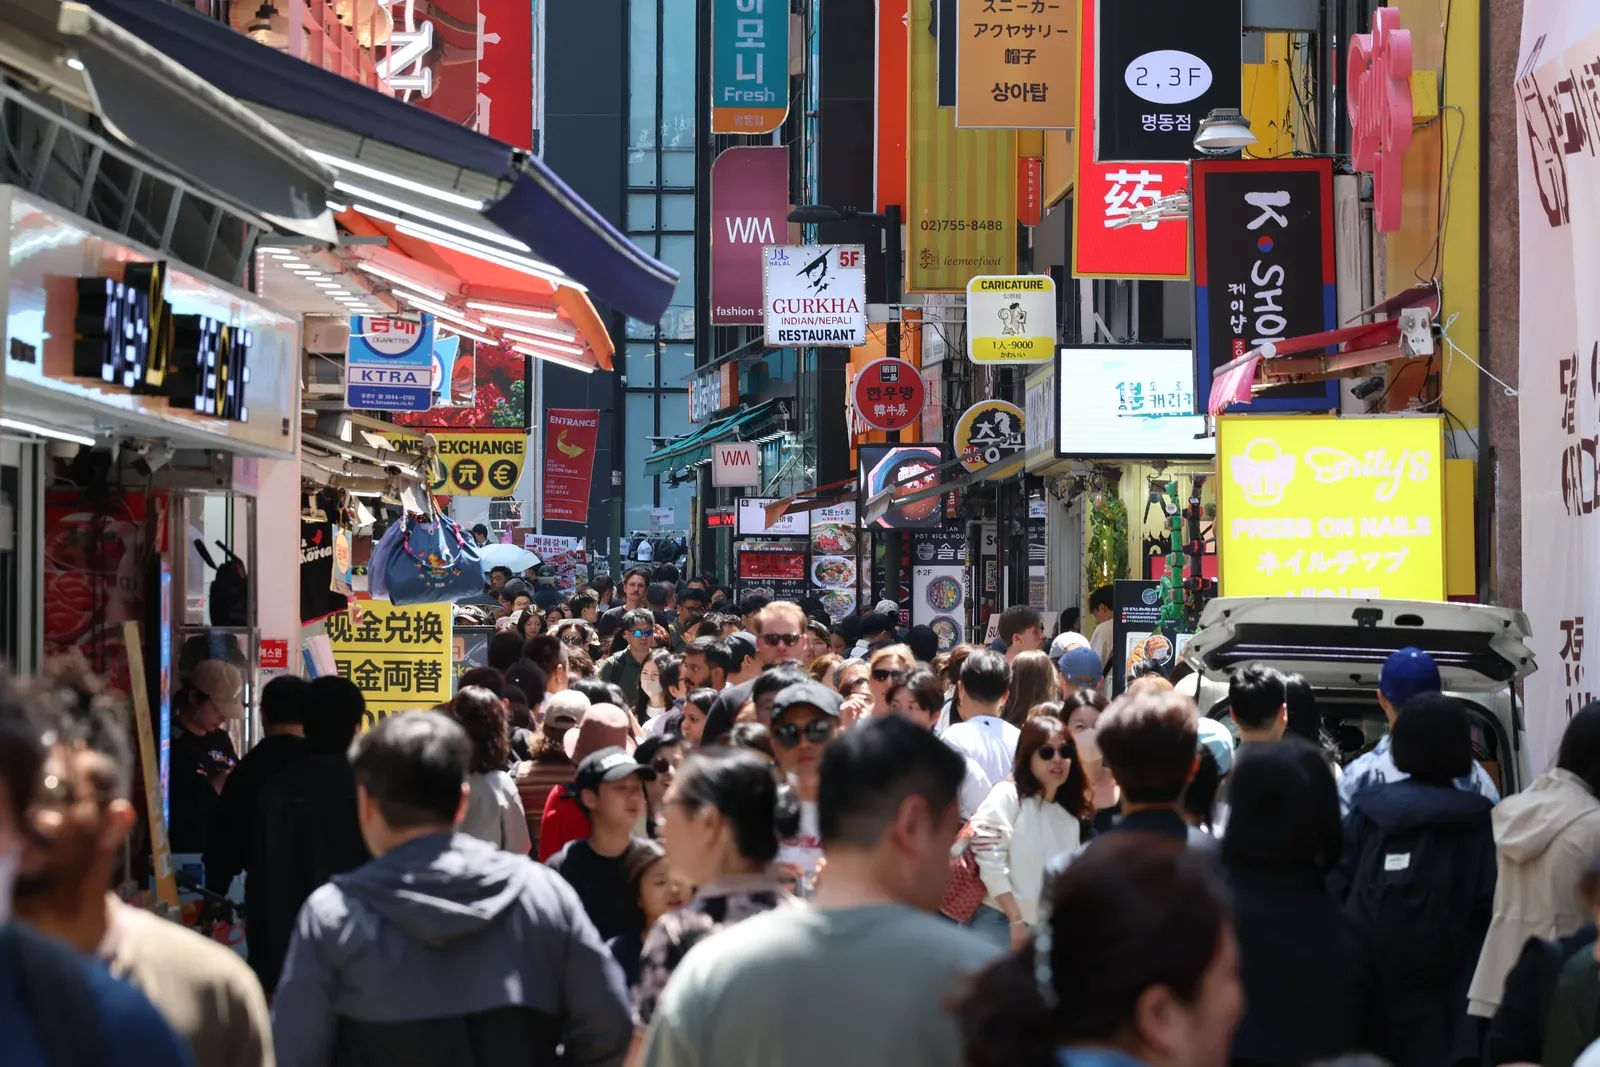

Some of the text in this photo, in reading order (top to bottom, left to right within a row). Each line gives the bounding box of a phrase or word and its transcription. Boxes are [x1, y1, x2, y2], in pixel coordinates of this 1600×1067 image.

[1005, 48, 1036, 64] 帽子
[724, 87, 775, 102] Fresh
[991, 83, 1048, 102] 상아탑
[1142, 114, 1191, 132] 명동점
[725, 217, 775, 243] WM
[921, 220, 1003, 232] 02)755-8488
[840, 251, 860, 267] 5F
[981, 280, 1044, 290] CARICATURE
[716, 306, 754, 316] fashion
[772, 298, 861, 314] GURKHA
[781, 316, 852, 326] INDIAN/NEPALI
[778, 329, 856, 342] RESTAURANT
[361, 370, 417, 383] KTRA
[550, 416, 596, 427] ENTRANCE
[439, 440, 523, 454] EXCHANGE
[722, 450, 751, 466] WM
[1304, 447, 1432, 502] Emily's
[1231, 515, 1432, 540] PRESS ON NAILS
[1256, 547, 1410, 576] ネイルチップ
[324, 610, 443, 645] 现金兑换
